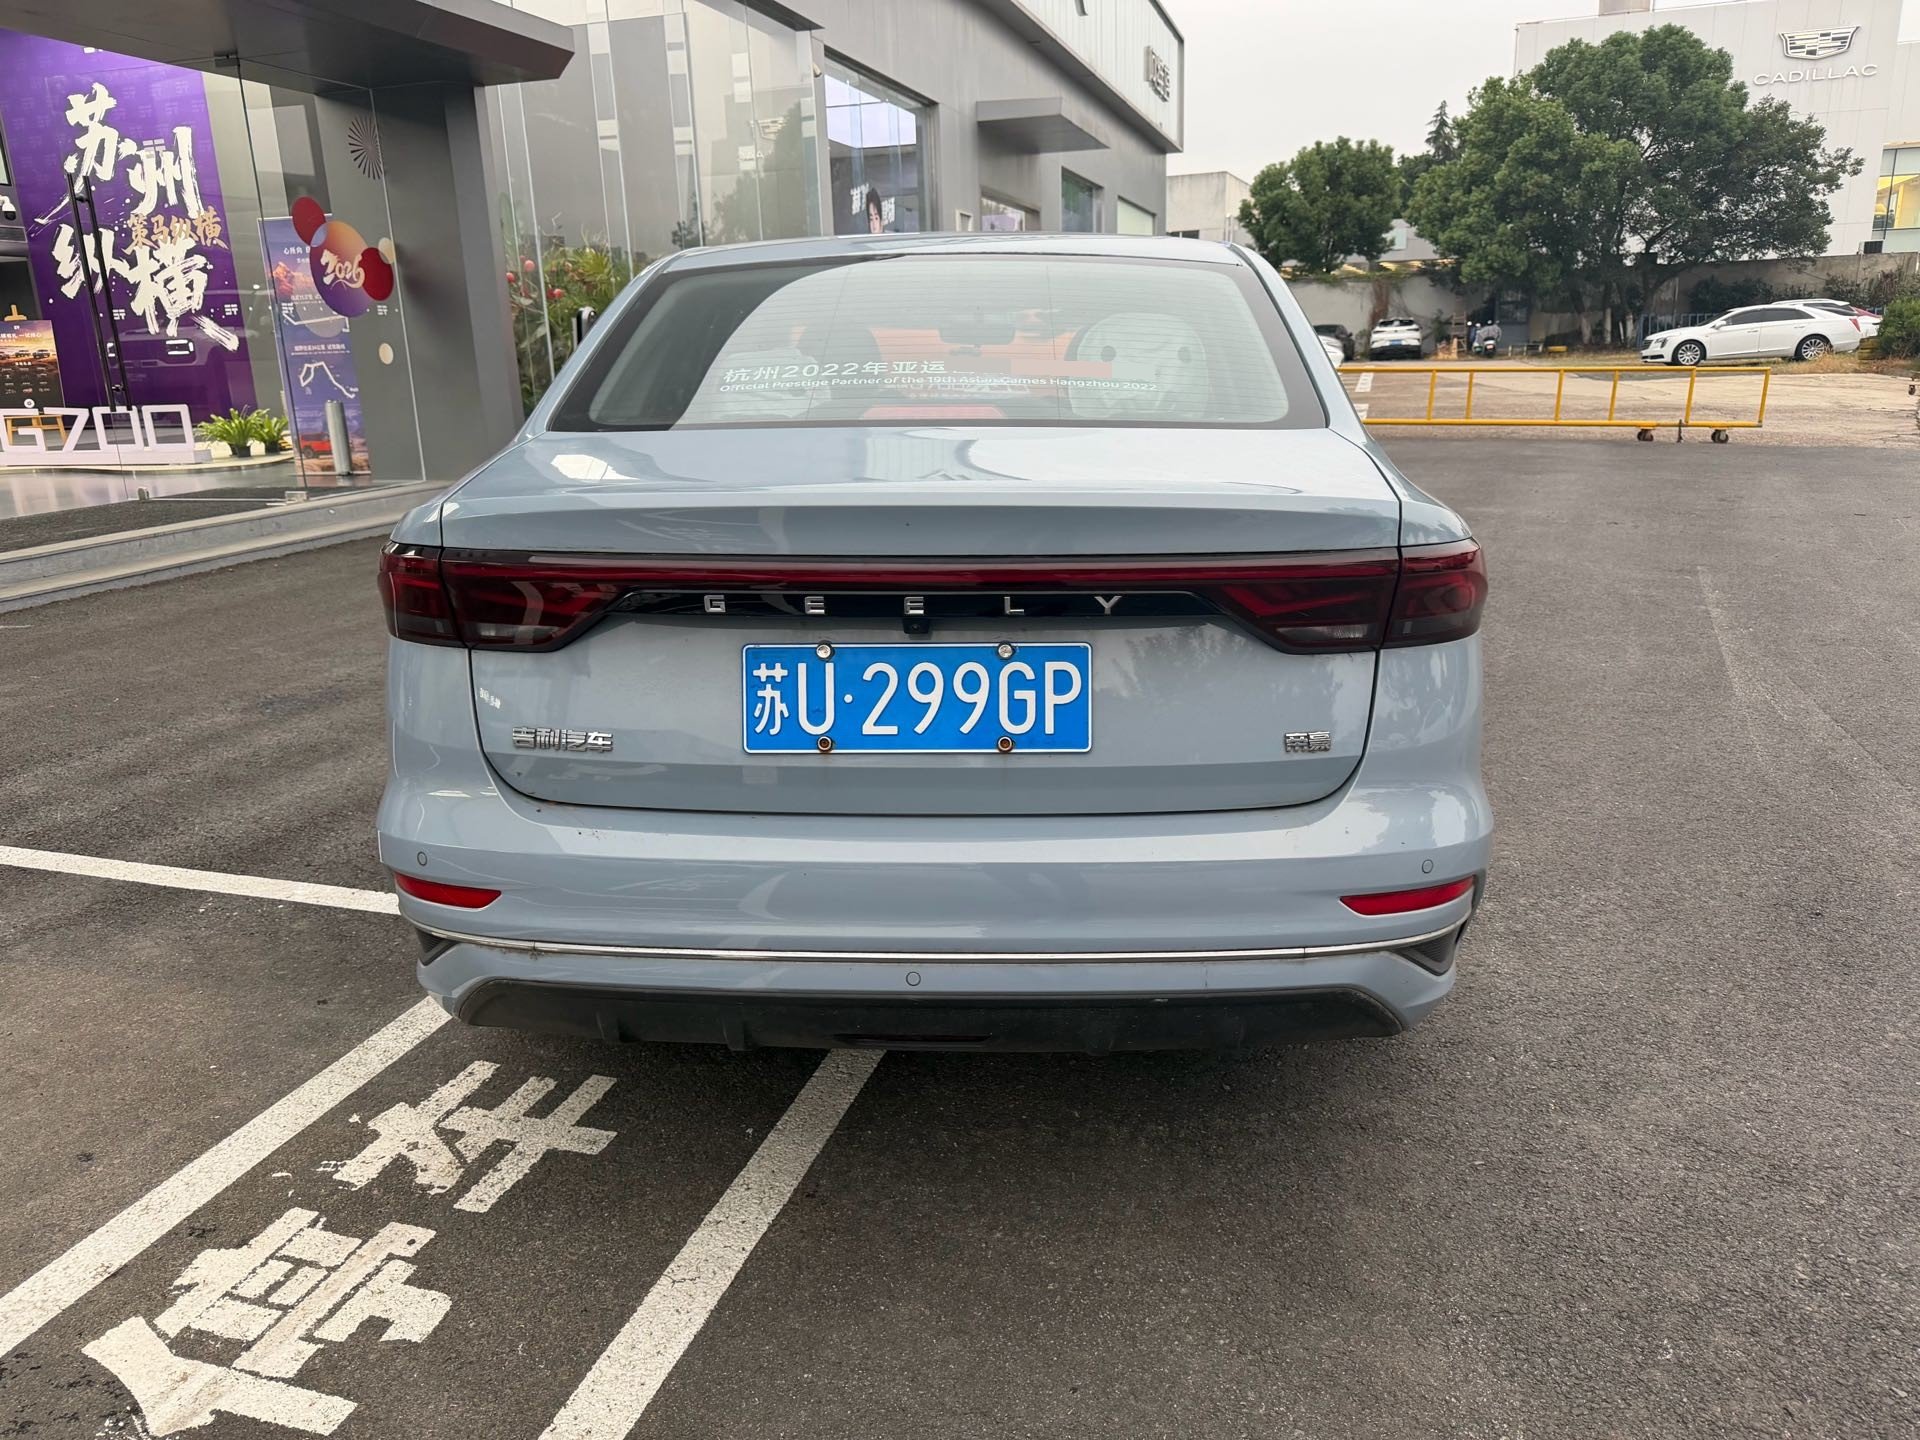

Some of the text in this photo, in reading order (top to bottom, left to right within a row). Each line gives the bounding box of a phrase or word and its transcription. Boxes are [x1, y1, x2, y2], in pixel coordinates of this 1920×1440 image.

[1753, 63, 1878, 87] CADILLAC
[122, 206, 229, 254] 策马纵横
[723, 360, 976, 383] 杭州2022年亚运
[719, 382, 769, 392] Official
[772, 379, 828, 389] Prestige
[831, 376, 880, 386] Partner
[884, 376, 899, 384] of
[901, 376, 924, 384] the
[927, 376, 956, 384] 19th
[1049, 378, 1121, 389] Hangzhou
[1122, 382, 1158, 391] 2022
[0, 404, 195, 451] G700
[703, 594, 1123, 617] GEELY
[752, 660, 1083, 737] 苏U·299GP
[511, 726, 614, 753] 吉利汽车
[1285, 731, 1331, 753] 帝豪
